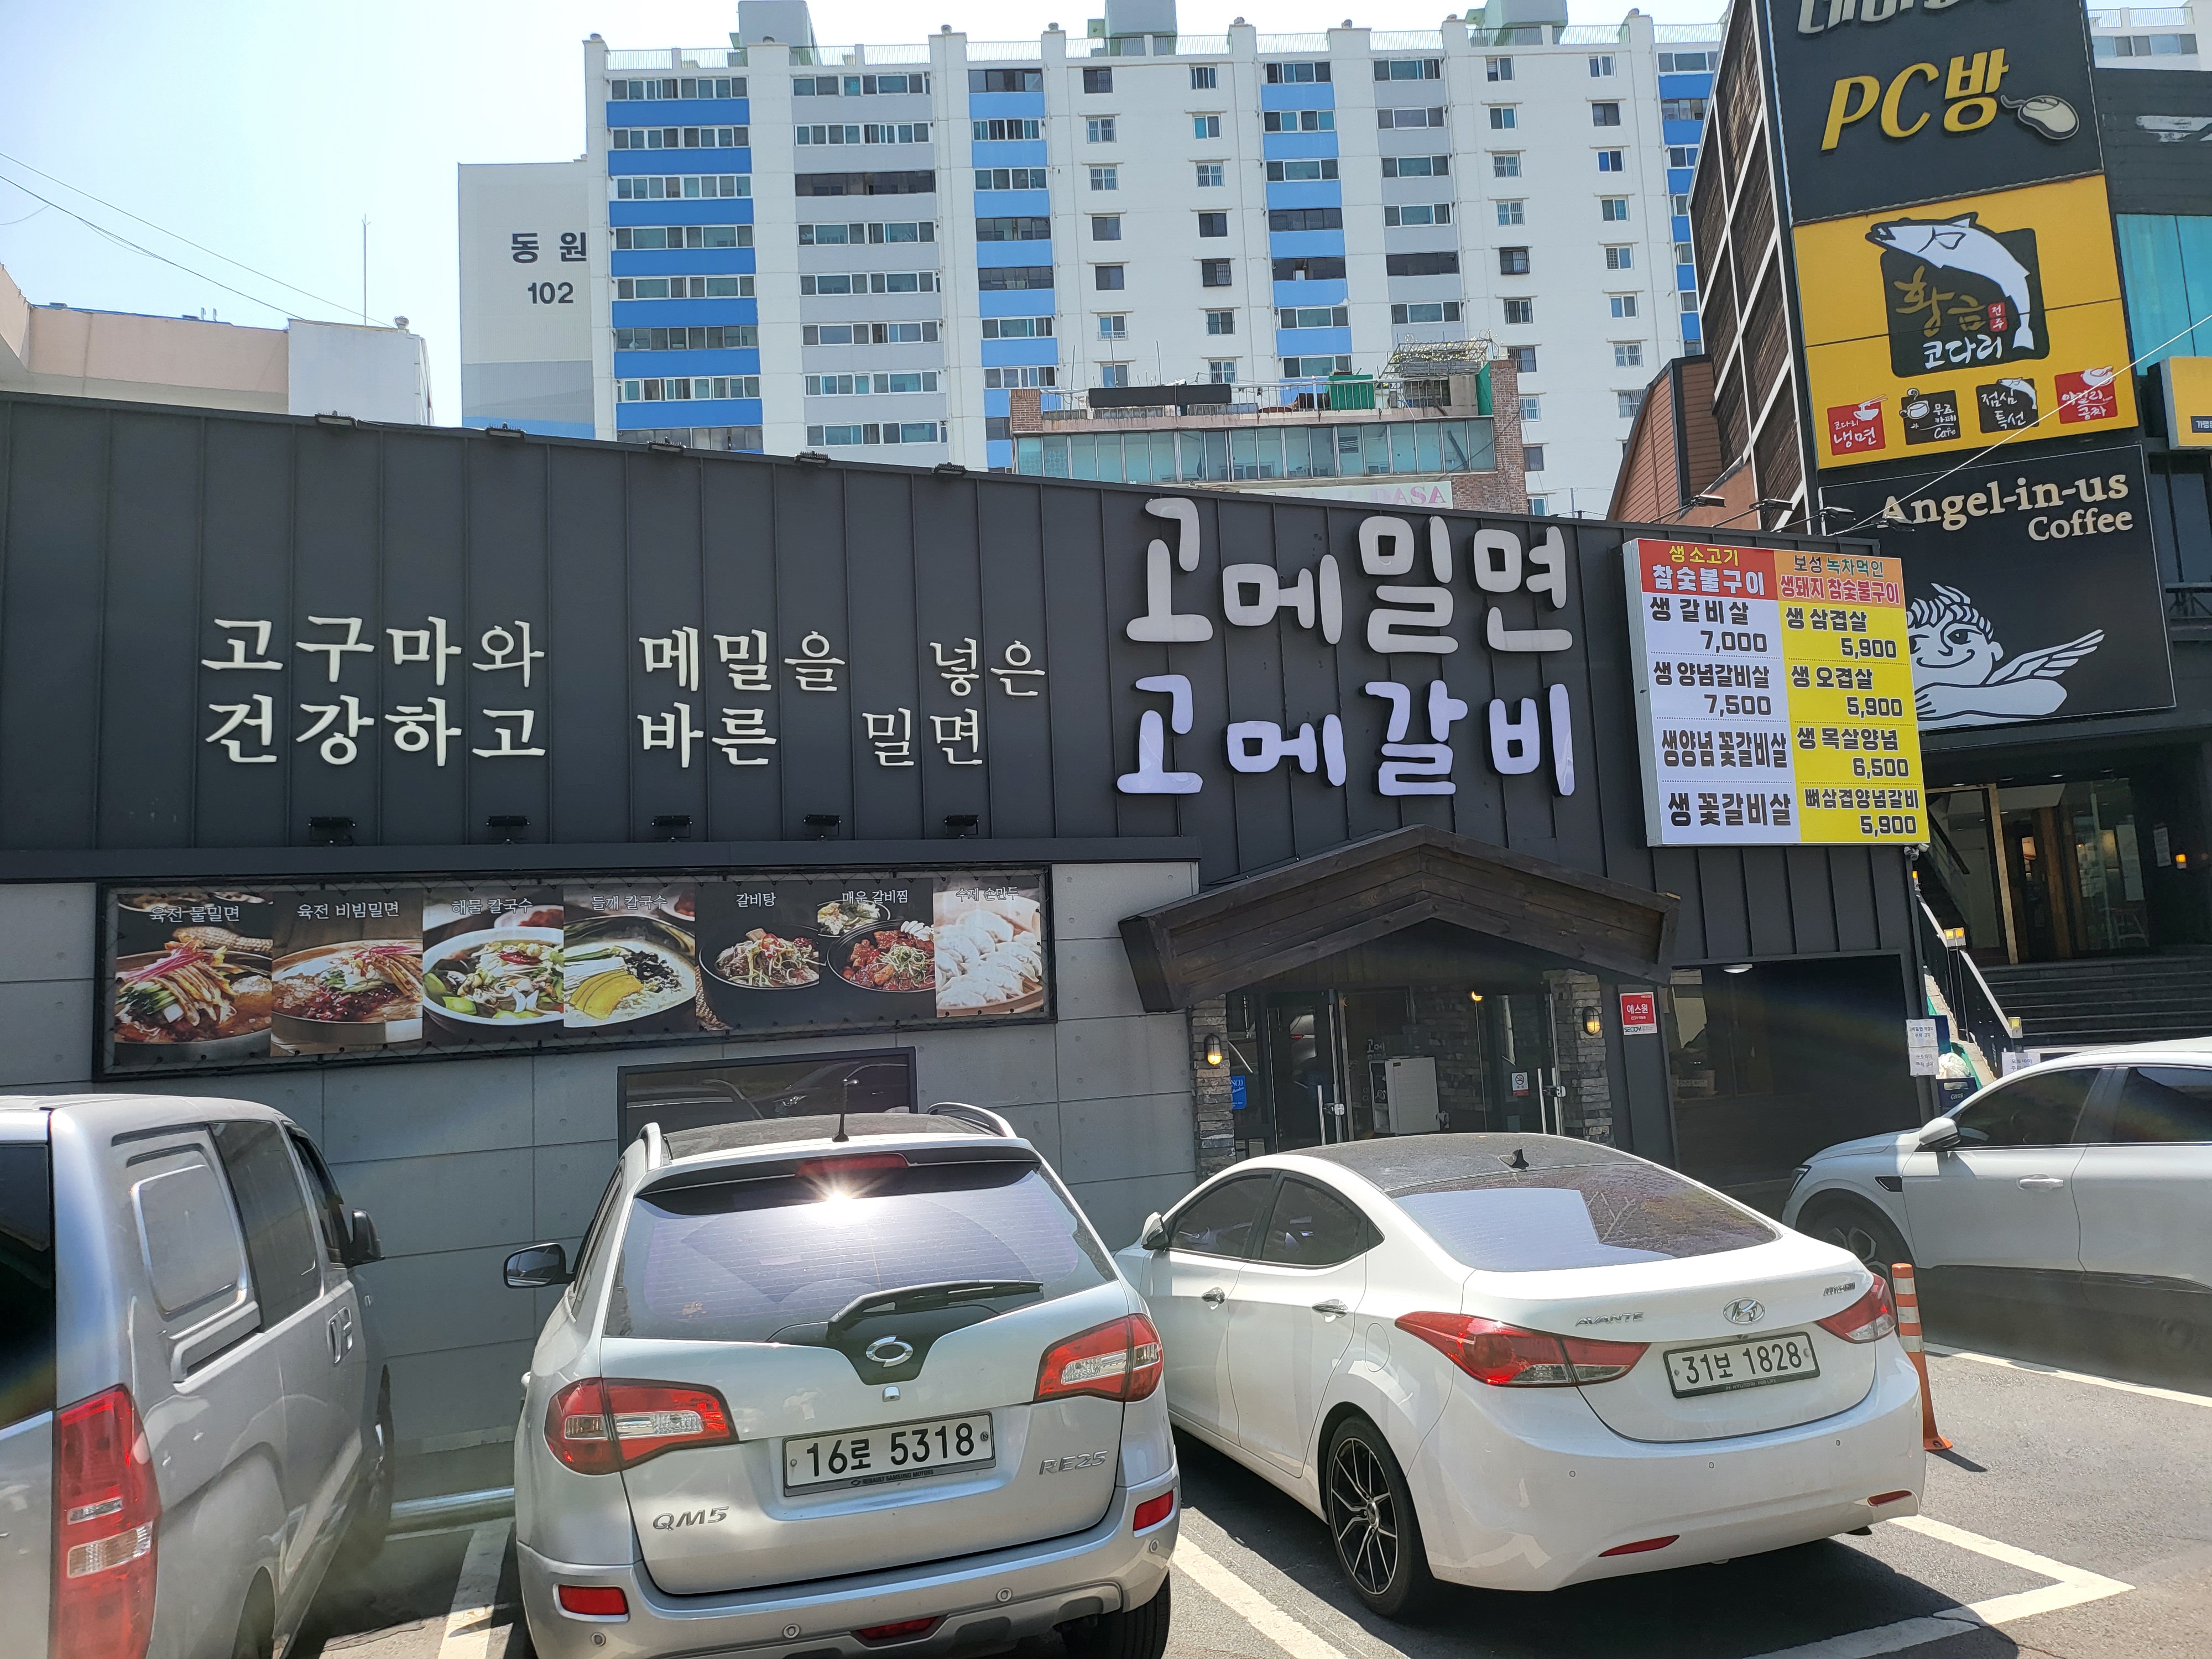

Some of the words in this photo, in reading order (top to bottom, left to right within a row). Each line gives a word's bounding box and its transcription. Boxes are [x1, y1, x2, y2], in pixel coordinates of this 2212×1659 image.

[1820, 48, 2009, 150] PC방
[511, 232, 587, 264] 동원
[527, 281, 574, 304] 102
[1893, 265, 1986, 338] 황금
[1923, 334, 2002, 369] 코다리
[1933, 403, 1955, 415] 무료
[1981, 389, 2017, 407] 점심
[1834, 420, 1859, 430] 코다리
[1934, 415, 1957, 423] 카페
[1994, 410, 2026, 430] 특선
[1833, 427, 1877, 448] 냉면
[1934, 429, 1957, 439] Cafe
[1877, 473, 2129, 531] Angel-in-us
[2028, 508, 2133, 541] Coffee
[1126, 498, 1574, 654] 고메밀면
[1793, 554, 1823, 573] 보성
[1827, 556, 1885, 578] 녹차먹인
[1652, 564, 1766, 596] 참숯불구이
[1780, 575, 1825, 600] 생돼지
[1827, 577, 1901, 605] 참숯불구이
[1785, 607, 1805, 630] 생
[1809, 608, 1867, 633] 삼겹살
[1699, 630, 1768, 654] 7,000
[1840, 637, 1897, 660] 5,900
[201, 615, 545, 687] 고구마와
[638, 625, 846, 692] 메밀을
[930, 637, 1046, 697] 넣은
[1653, 661, 1673, 686] 생
[1677, 661, 1770, 689] 양념갈비살
[1791, 665, 1811, 688] 생
[1815, 666, 1874, 690] 오겹살
[1703, 693, 1772, 717] 7,500
[1845, 695, 1904, 719] 5,900
[205, 693, 546, 767] 건강하고
[637, 701, 778, 769] 바른
[862, 707, 983, 766] 밀면
[1796, 727, 1817, 750] 생
[1820, 727, 1900, 752] 목살양념
[1661, 729, 1715, 768] 생양념
[1718, 731, 1788, 768] 꽃갈비살
[1852, 756, 1910, 780] 6,500
[1668, 792, 1691, 827] 생
[1697, 792, 1791, 827] 꽃갈비살
[1859, 814, 1917, 838] 5,900
[591, 895, 619, 911] 들깨
[624, 894, 668, 910] 칼국수
[735, 893, 776, 907] 갈비탕
[841, 891, 868, 905] 매운
[871, 890, 909, 905] 갈비찜
[956, 888, 980, 902] 수제
[983, 886, 1020, 901] 손만두
[149, 905, 184, 924] 육전
[189, 904, 240, 922] 물밀면
[296, 903, 330, 920] 육전
[335, 901, 399, 919] 비빔밀면
[451, 899, 483, 915] 해물
[487, 898, 534, 914] 칼국수
[1626, 1003, 1648, 1015] 에스원
[1574, 1312, 1644, 1327] AVANTE
[1682, 1353, 1734, 1384] 31보
[1742, 1341, 1802, 1375] 1828
[806, 1438, 872, 1477] 16로
[890, 1422, 975, 1465] 5318
[1039, 1449, 1109, 1475] RE25
[862, 1476, 885, 1485] RENAULT
[885, 1472, 912, 1481] SAMSUNG
[912, 1469, 934, 1478] MOTORS
[653, 1505, 729, 1531] QM5
